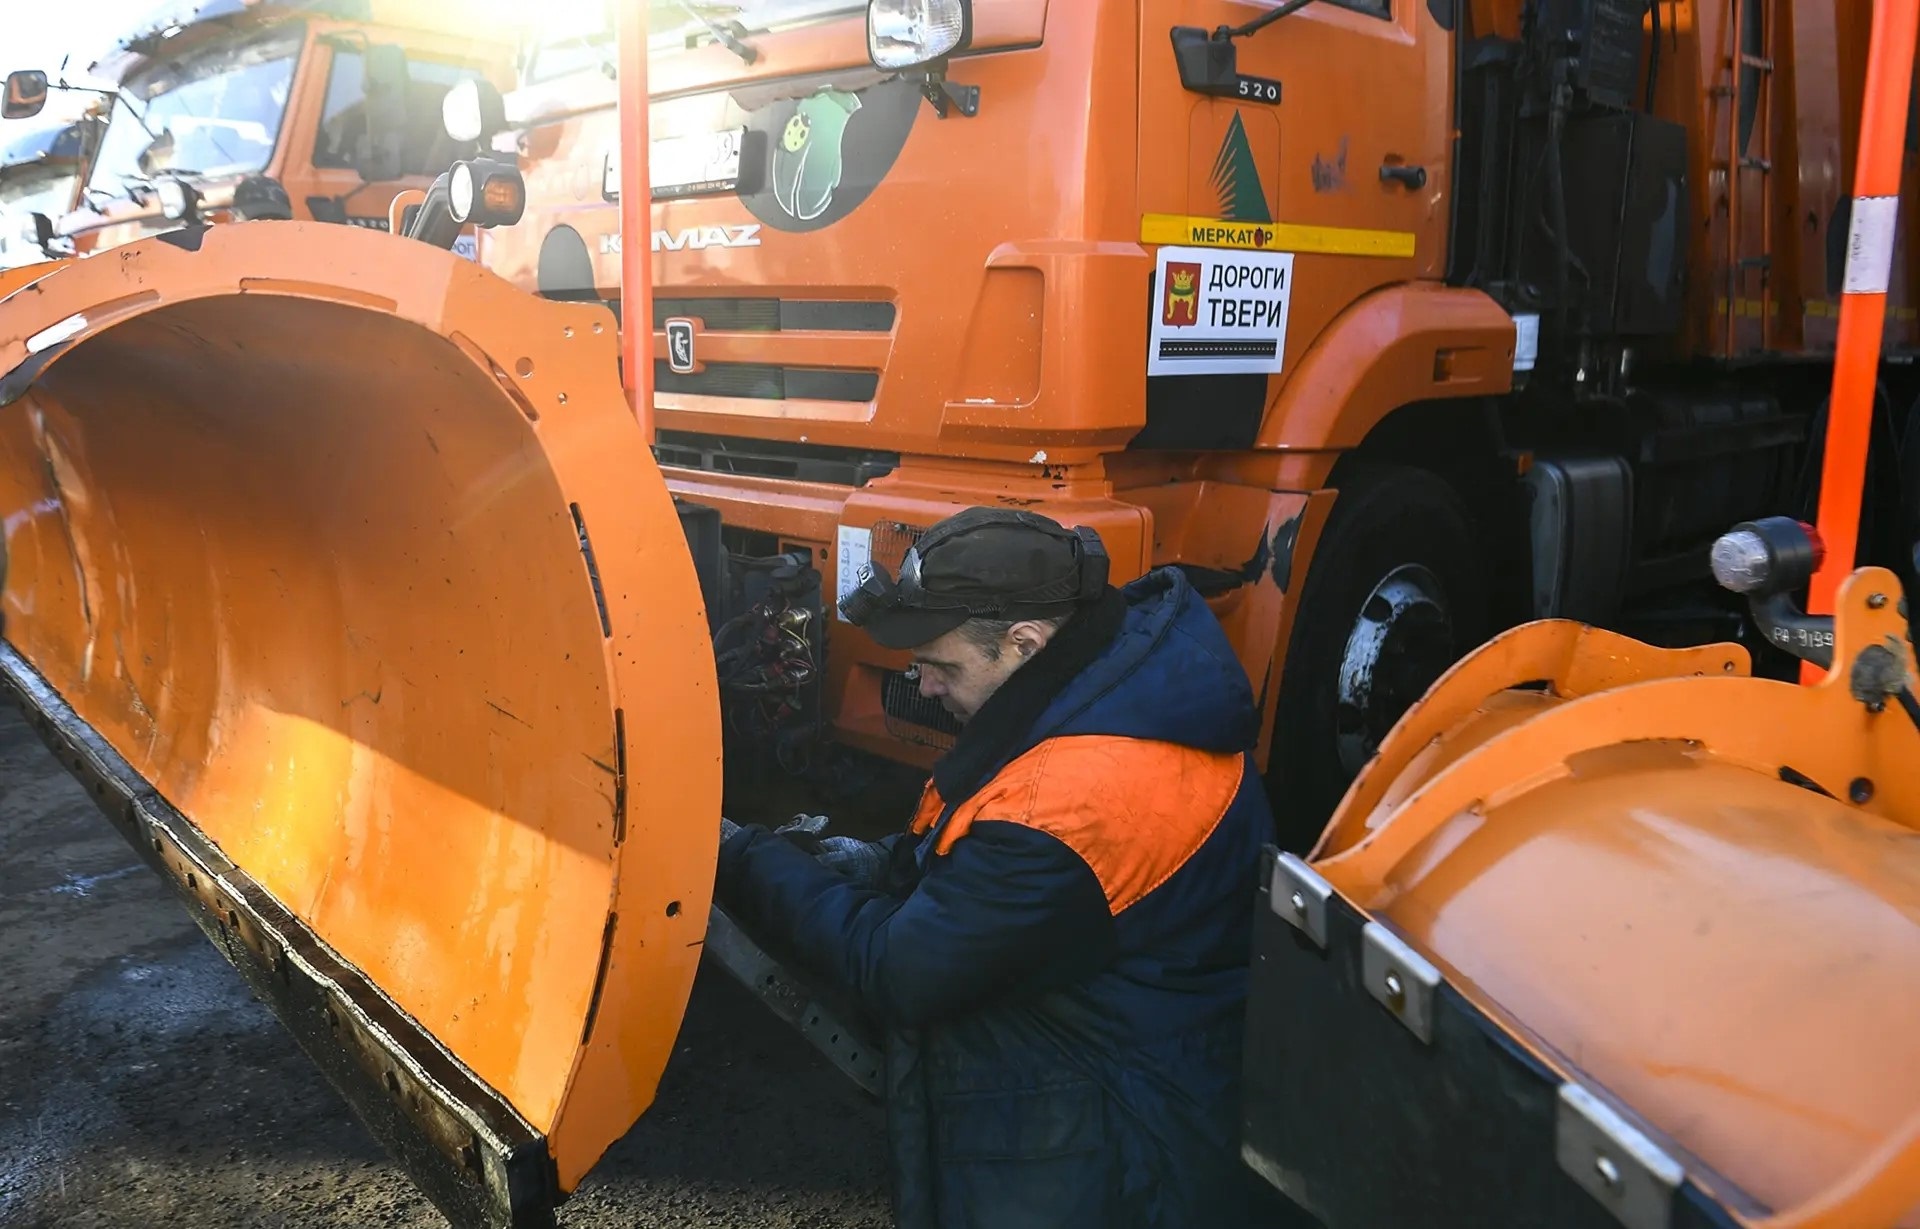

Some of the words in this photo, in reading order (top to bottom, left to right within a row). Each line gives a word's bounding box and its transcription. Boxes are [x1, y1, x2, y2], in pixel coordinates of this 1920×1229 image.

[600, 224, 761, 254] KMAZ
[1192, 227, 1273, 247] МЕРКАТОР
[1209, 264, 1284, 291] ДОРОГИ
[1208, 298, 1282, 328] ТВЕРИ
